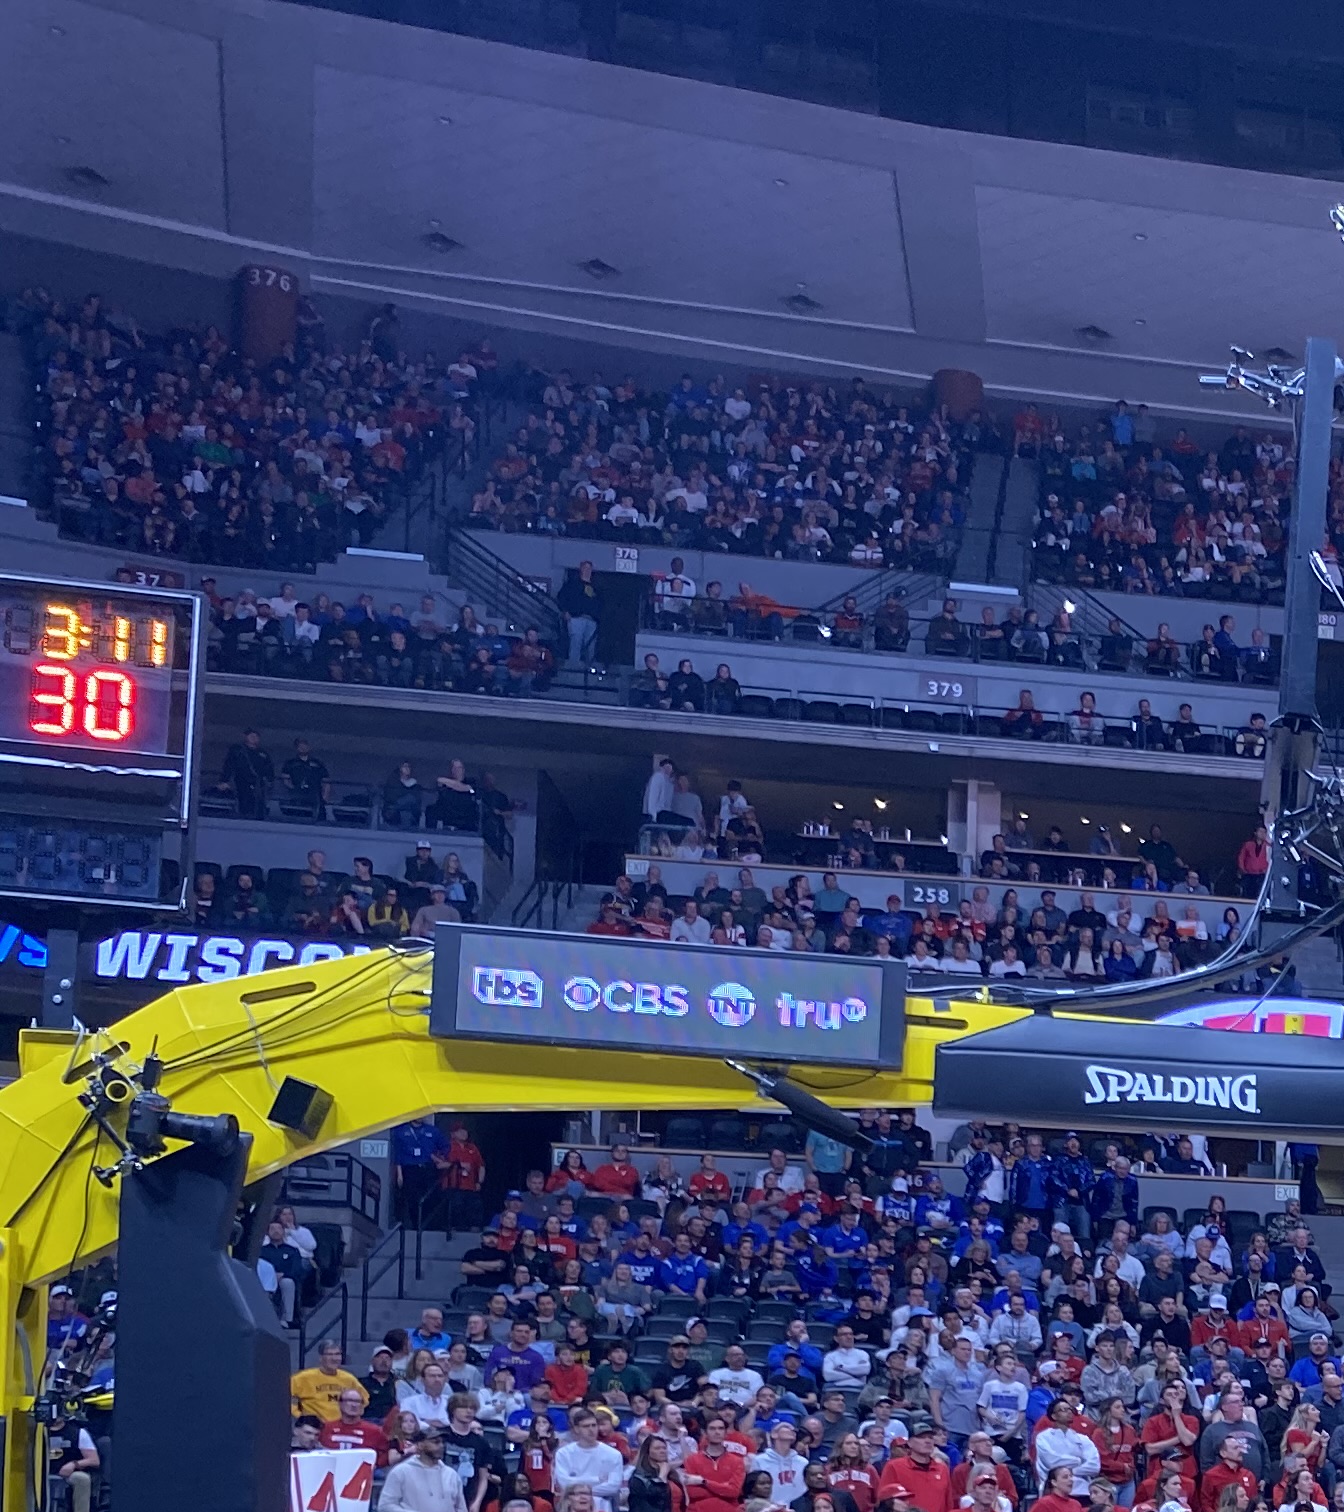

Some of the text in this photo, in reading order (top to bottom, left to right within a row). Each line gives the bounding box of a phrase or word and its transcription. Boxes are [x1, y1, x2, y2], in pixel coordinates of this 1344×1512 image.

[249, 265, 292, 293] 376
[43, 604, 168, 667] 3:11
[31, 664, 133, 741] 30
[927, 681, 964, 697] 379
[913, 887, 951, 905] 258
[96, 930, 372, 984] WISC
[602, 979, 690, 1018] CBS
[1084, 1064, 1258, 1114] SPALDING
[362, 1141, 388, 1157] EXIT
